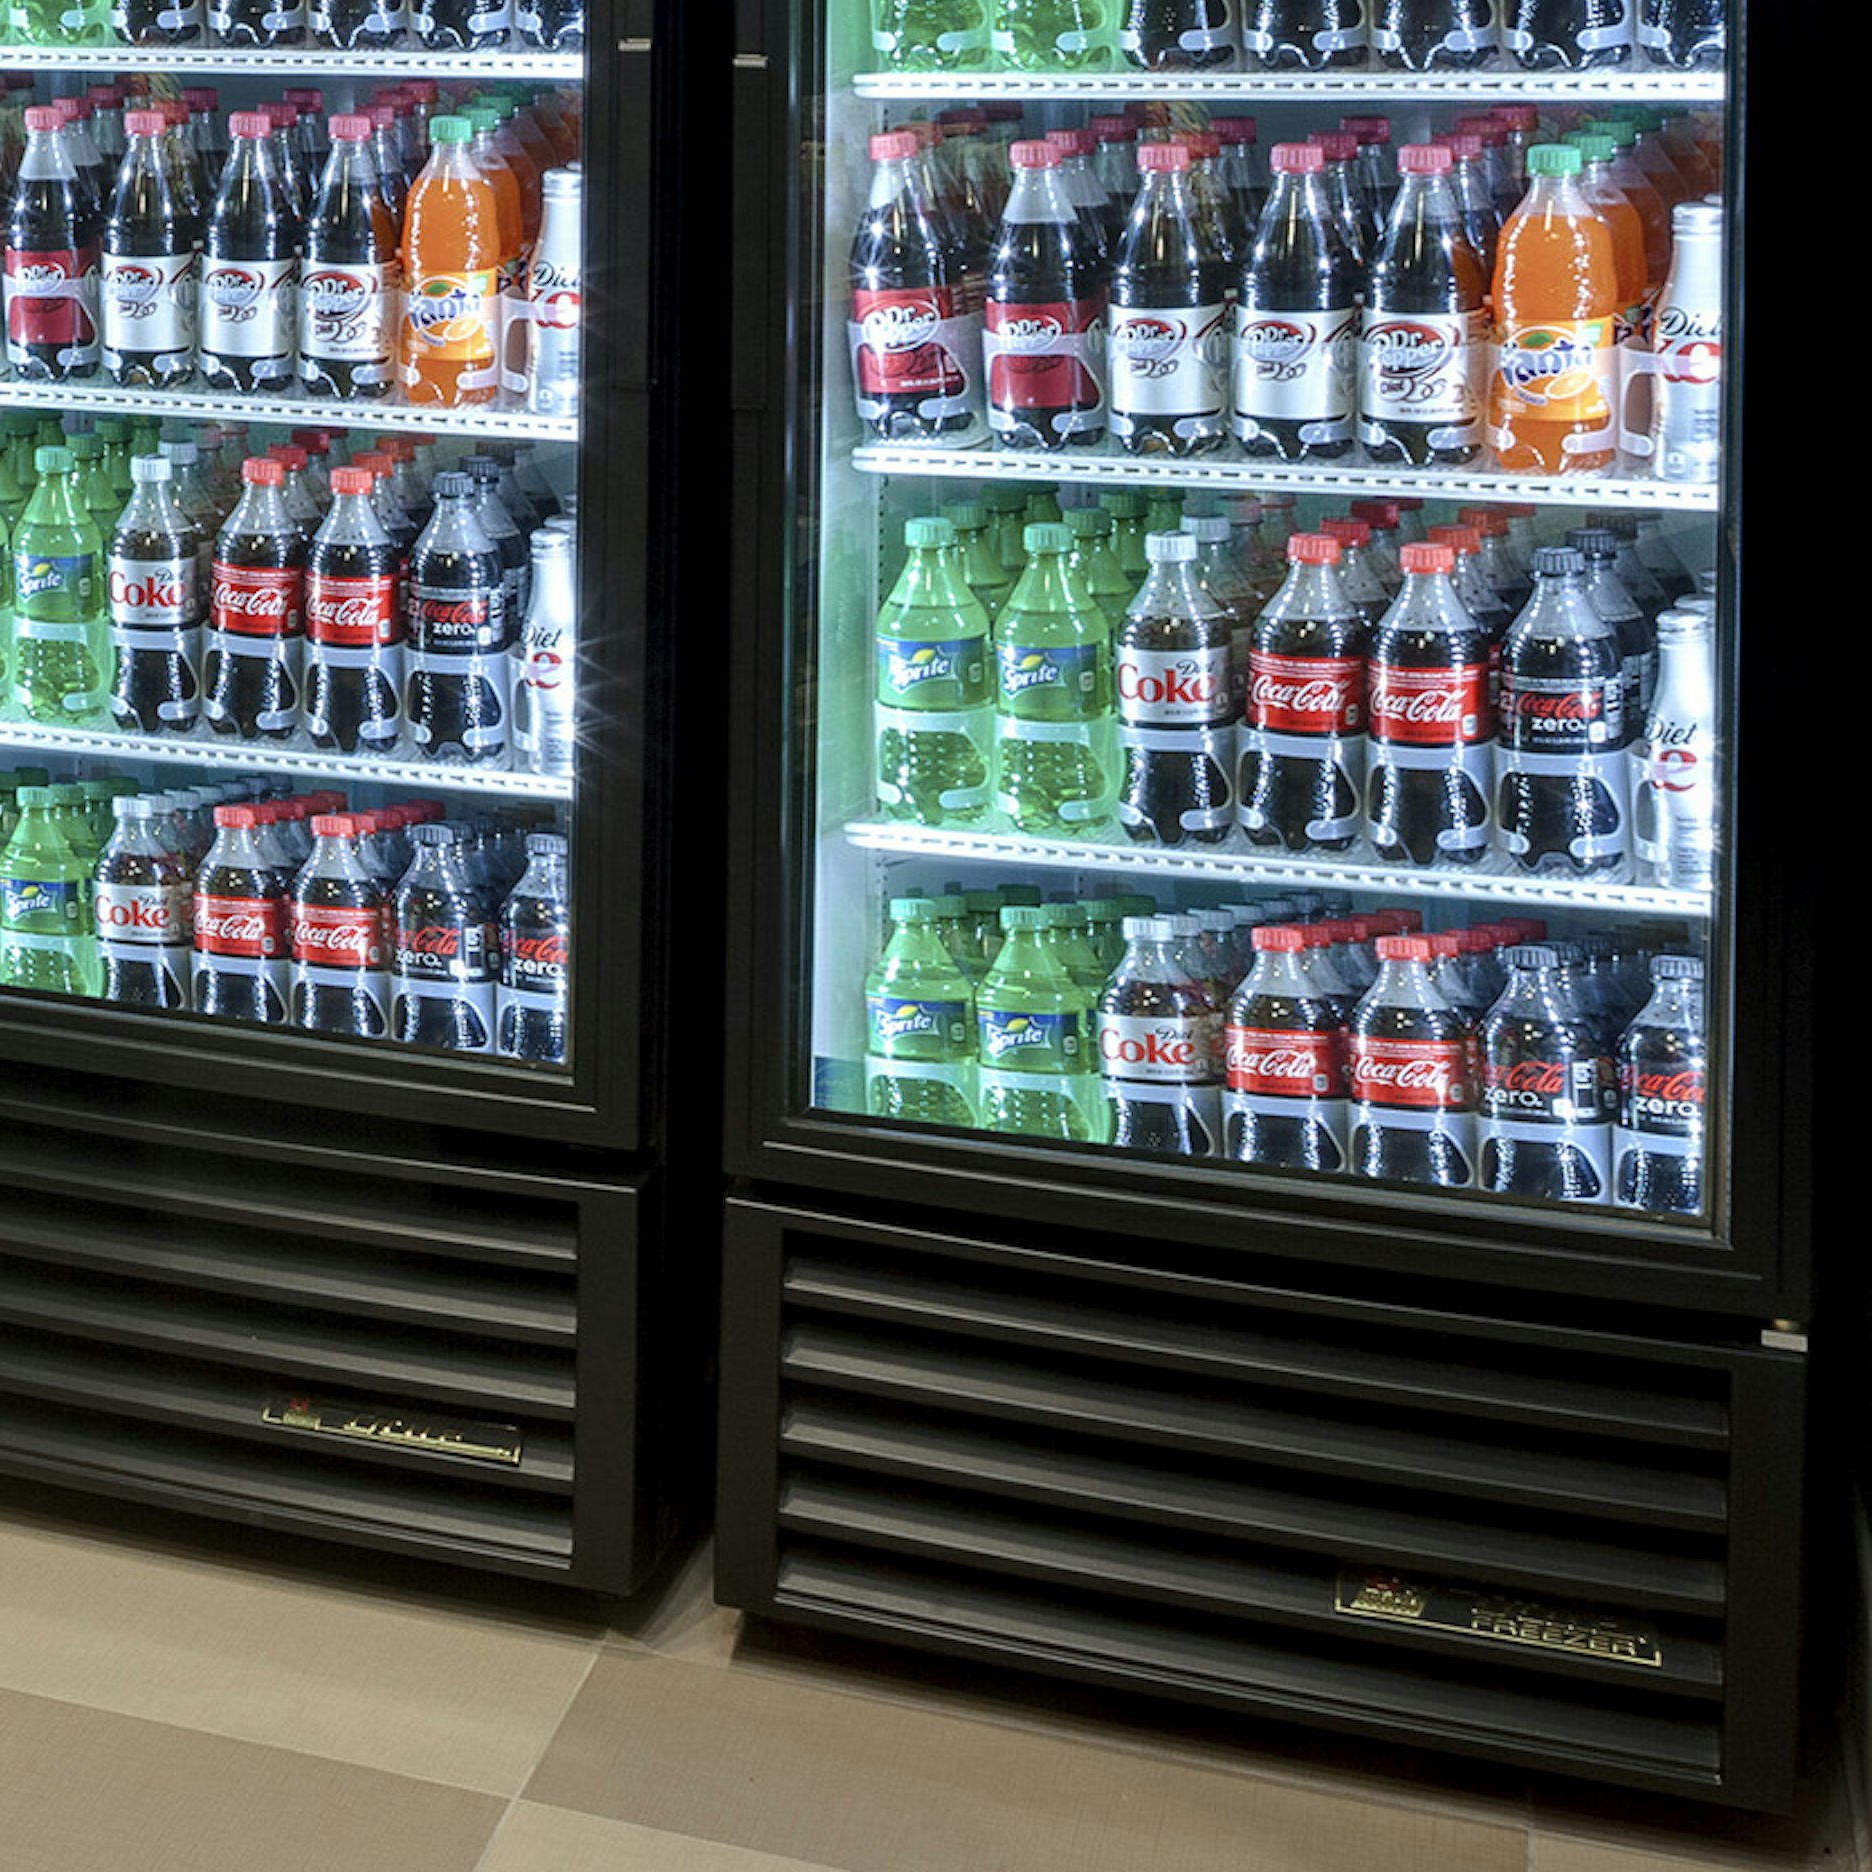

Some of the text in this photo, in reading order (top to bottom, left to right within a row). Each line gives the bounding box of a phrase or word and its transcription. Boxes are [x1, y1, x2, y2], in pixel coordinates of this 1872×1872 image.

[18, 572, 63, 597] Sprite
[108, 571, 186, 608] Coke
[213, 581, 289, 616] Coca-Cola
[308, 595, 379, 627] Coca-Cola
[521, 625, 562, 651] Diet
[889, 657, 950, 689] Sprite
[1003, 664, 1058, 692] Sprite
[1118, 662, 1217, 704] Coke
[1250, 674, 1349, 714] Coca-Cola
[1370, 682, 1464, 722] Coca-Cola
[1643, 719, 1698, 747] Diet
[94, 894, 169, 929] Coke
[195, 912, 264, 942] Coca-Cola
[295, 921, 369, 950] Coca-Cola
[877, 1014, 932, 1042] Sprite
[988, 1025, 1045, 1055] Sprite
[1099, 1026, 1196, 1065] Coke
[1225, 1043, 1317, 1079] Coca-Cola
[1356, 1054, 1452, 1090] Coca-Cola
[1470, 1608, 1647, 1658] FREEZER
